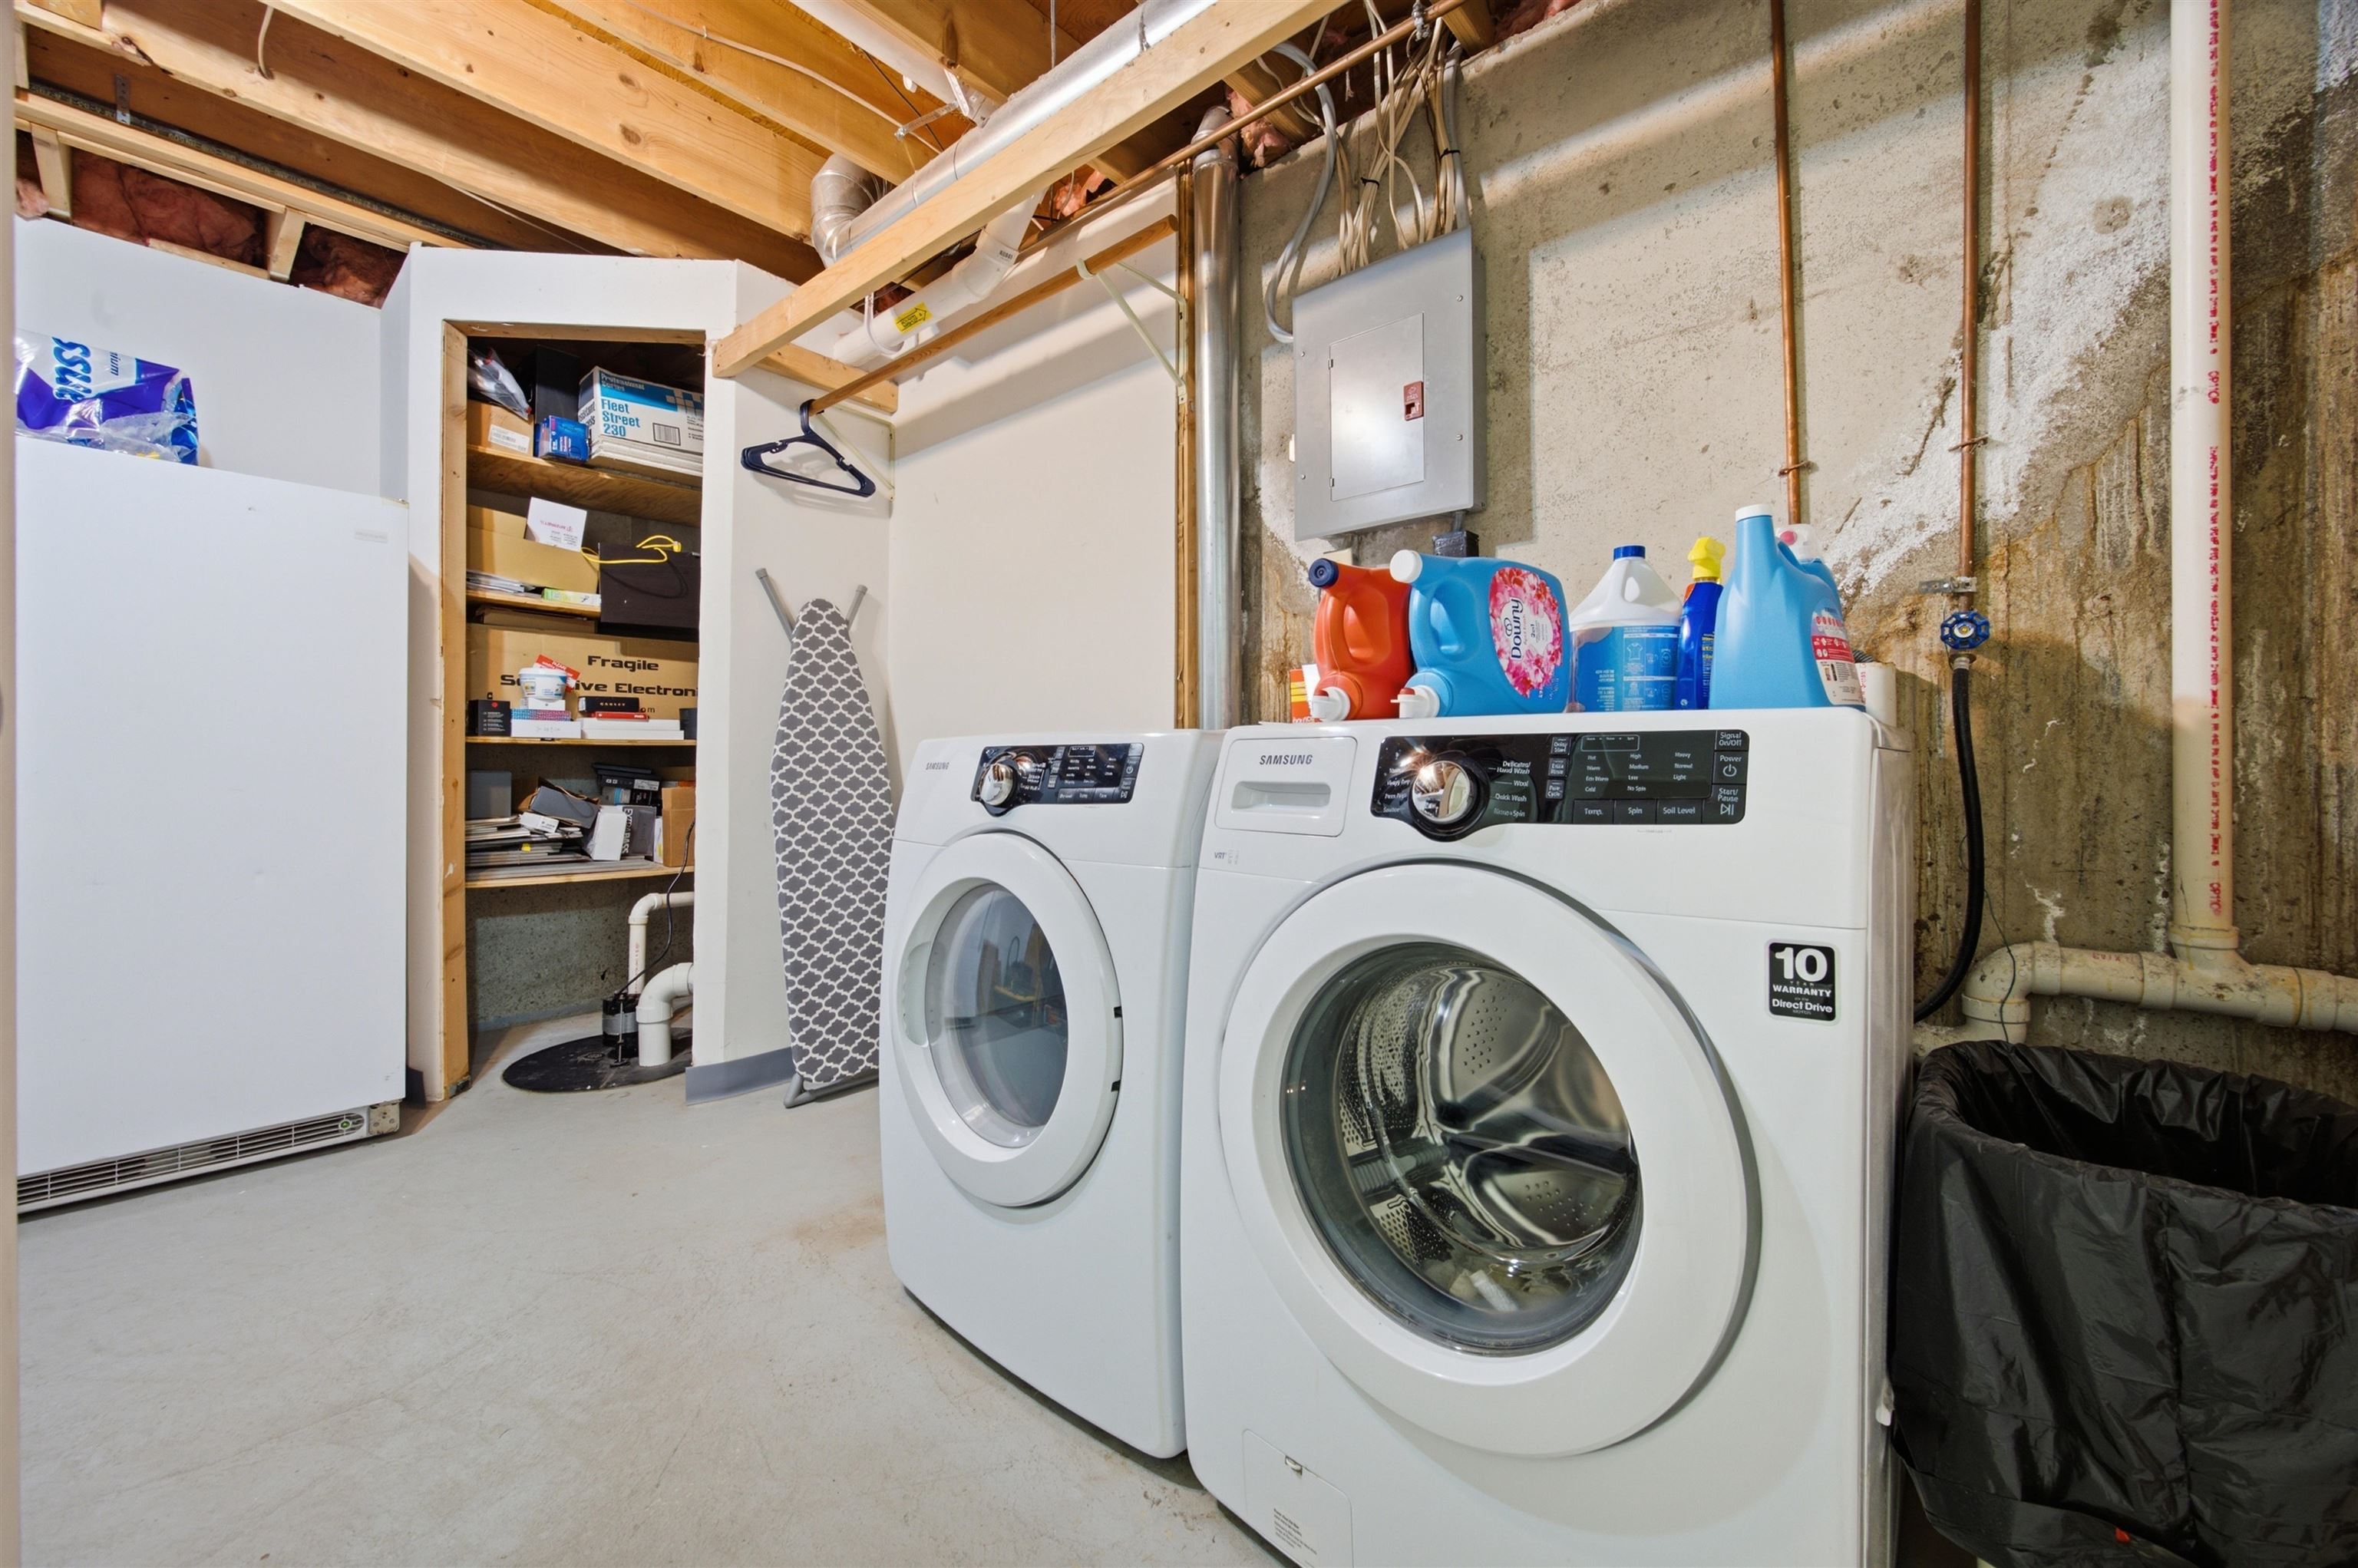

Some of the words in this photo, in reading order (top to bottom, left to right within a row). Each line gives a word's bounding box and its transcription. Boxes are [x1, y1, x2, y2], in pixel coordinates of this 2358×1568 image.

[601, 399, 629, 414] Fleet
[602, 411, 640, 427] Street
[603, 424, 626, 437] 230
[1511, 599, 1524, 659] Downy
[588, 655, 659, 672] Fragile
[1260, 754, 1313, 765] SAMSUNG
[1628, 807, 1643, 816] Spin
[1775, 947, 1828, 982] 10
[1772, 985, 1831, 997] WARRANTY
[1772, 999, 1803, 1009] Direct
[1805, 1002, 1832, 1013] Drive
